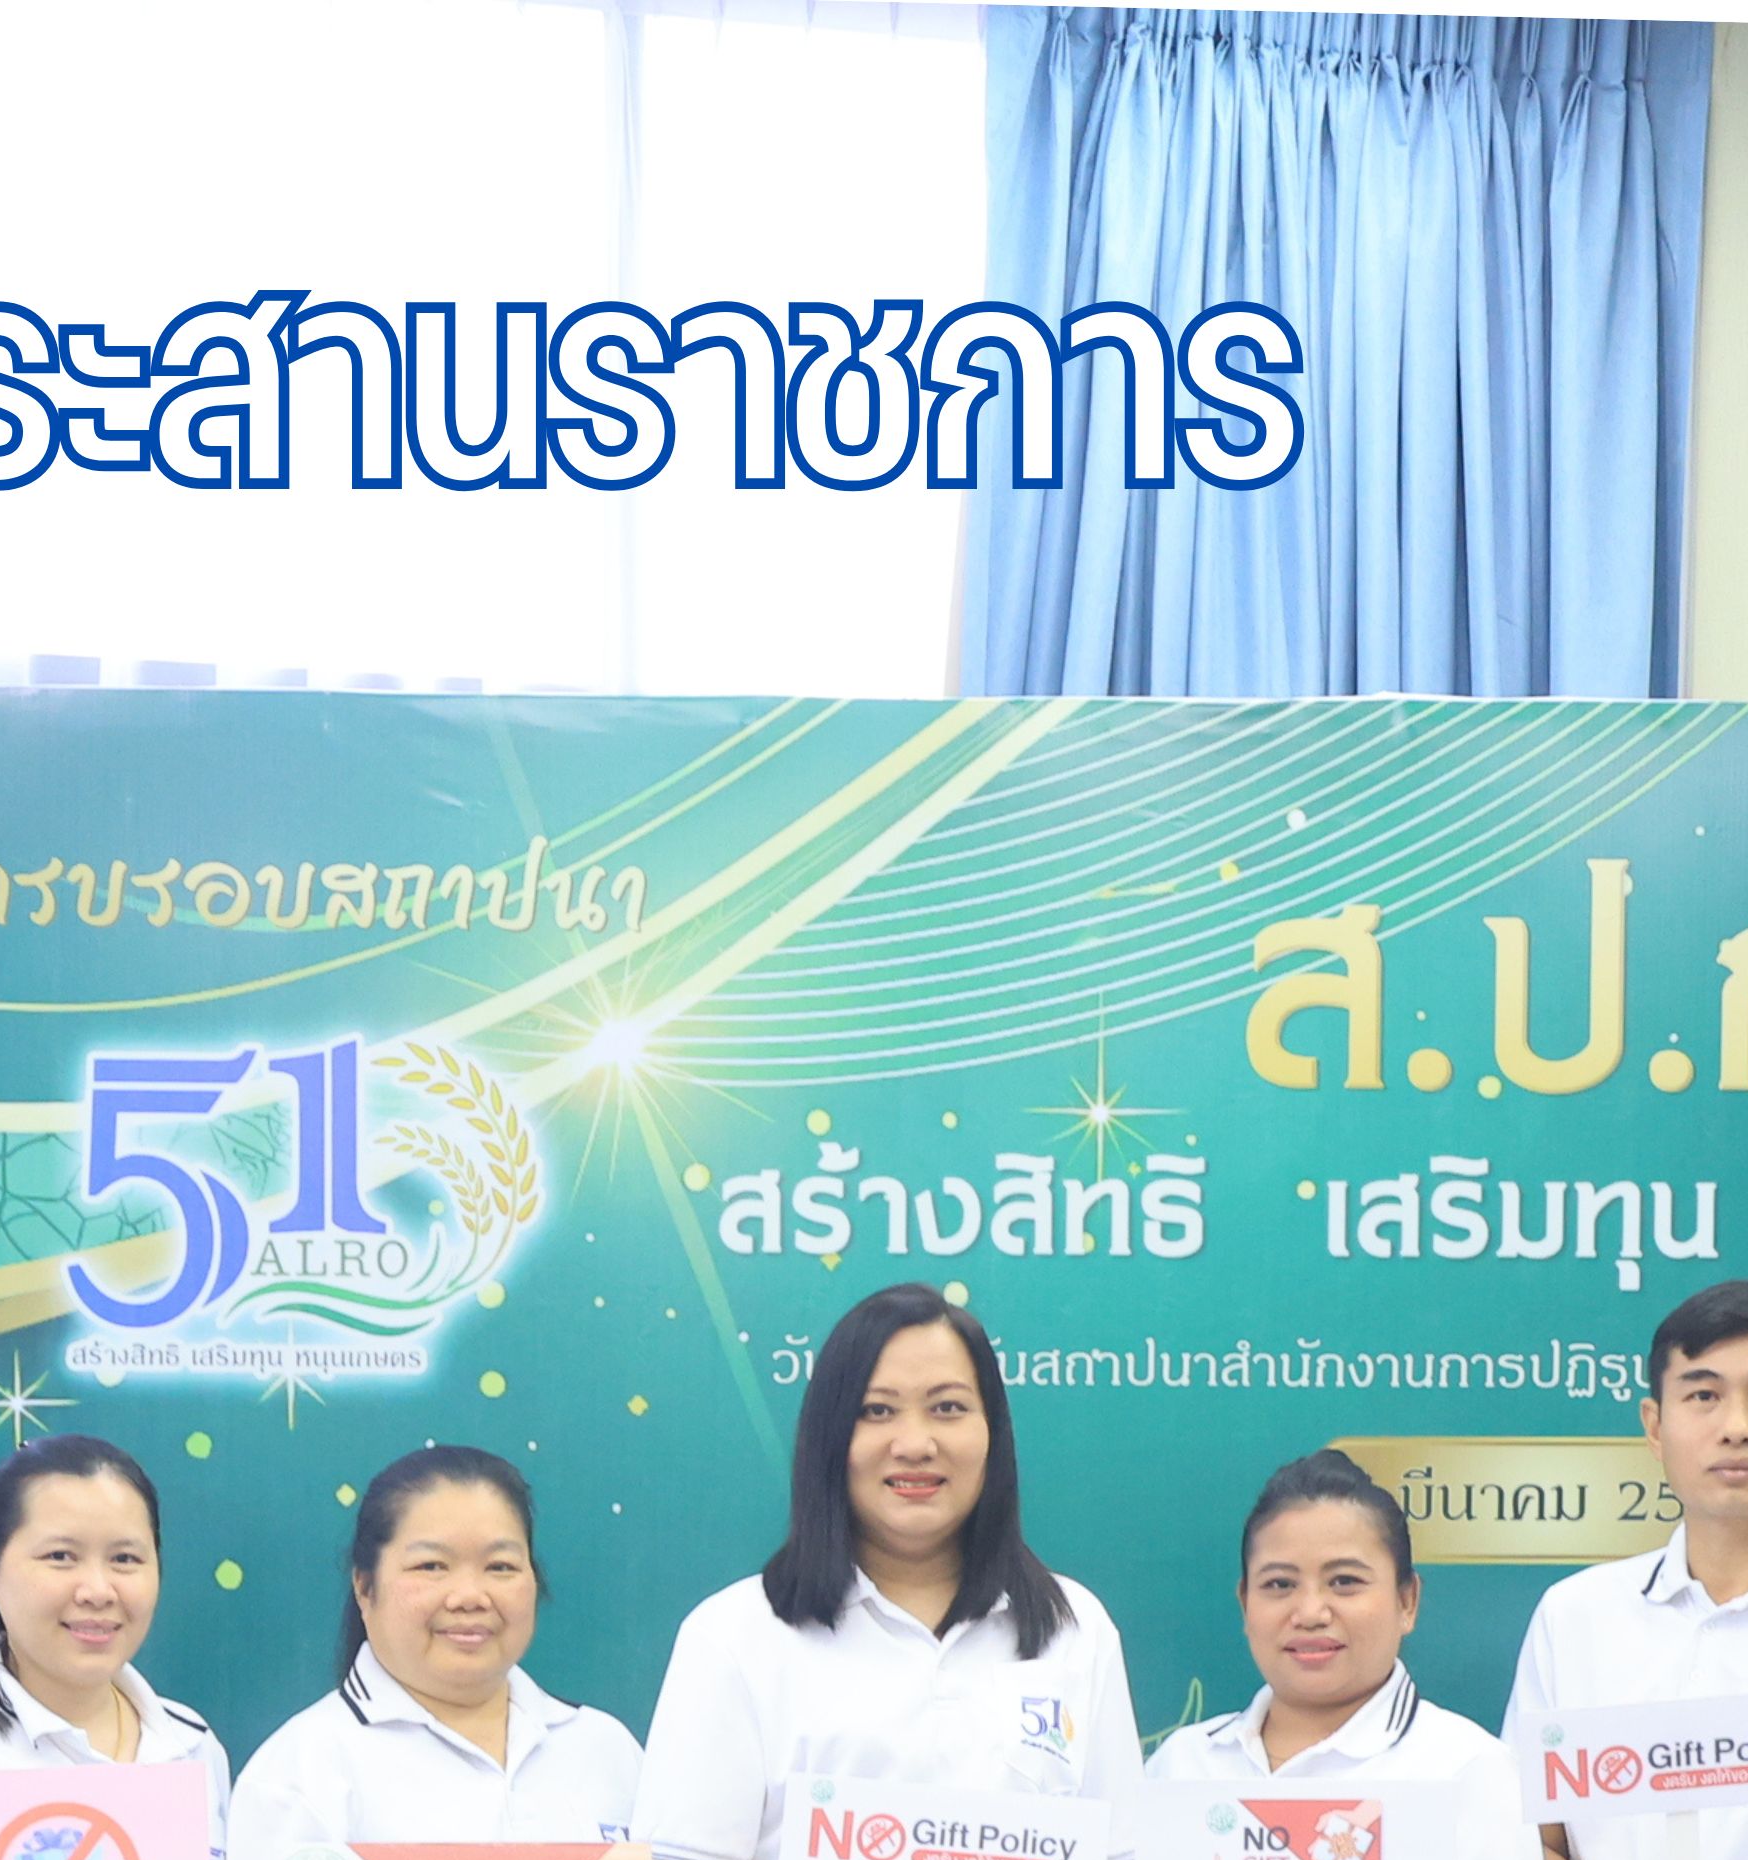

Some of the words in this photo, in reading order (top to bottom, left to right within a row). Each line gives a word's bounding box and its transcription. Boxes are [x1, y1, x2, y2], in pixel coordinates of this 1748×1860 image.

[66, 1039, 387, 1328] 51
[717, 1141, 1208, 1259] สร้างสิทธิ
[1326, 1155, 1719, 1292] เสริมทุน
[251, 1240, 408, 1279] ALRO
[192, 1345, 283, 1374] เสริมทุน
[295, 1350, 422, 1374] หนุนเกษตร
[1399, 1466, 1588, 1521] มีนาคม
[1648, 1741, 1704, 1769] Gift
[912, 1819, 968, 1848] Gift
[1244, 1827, 1290, 1851] NO
